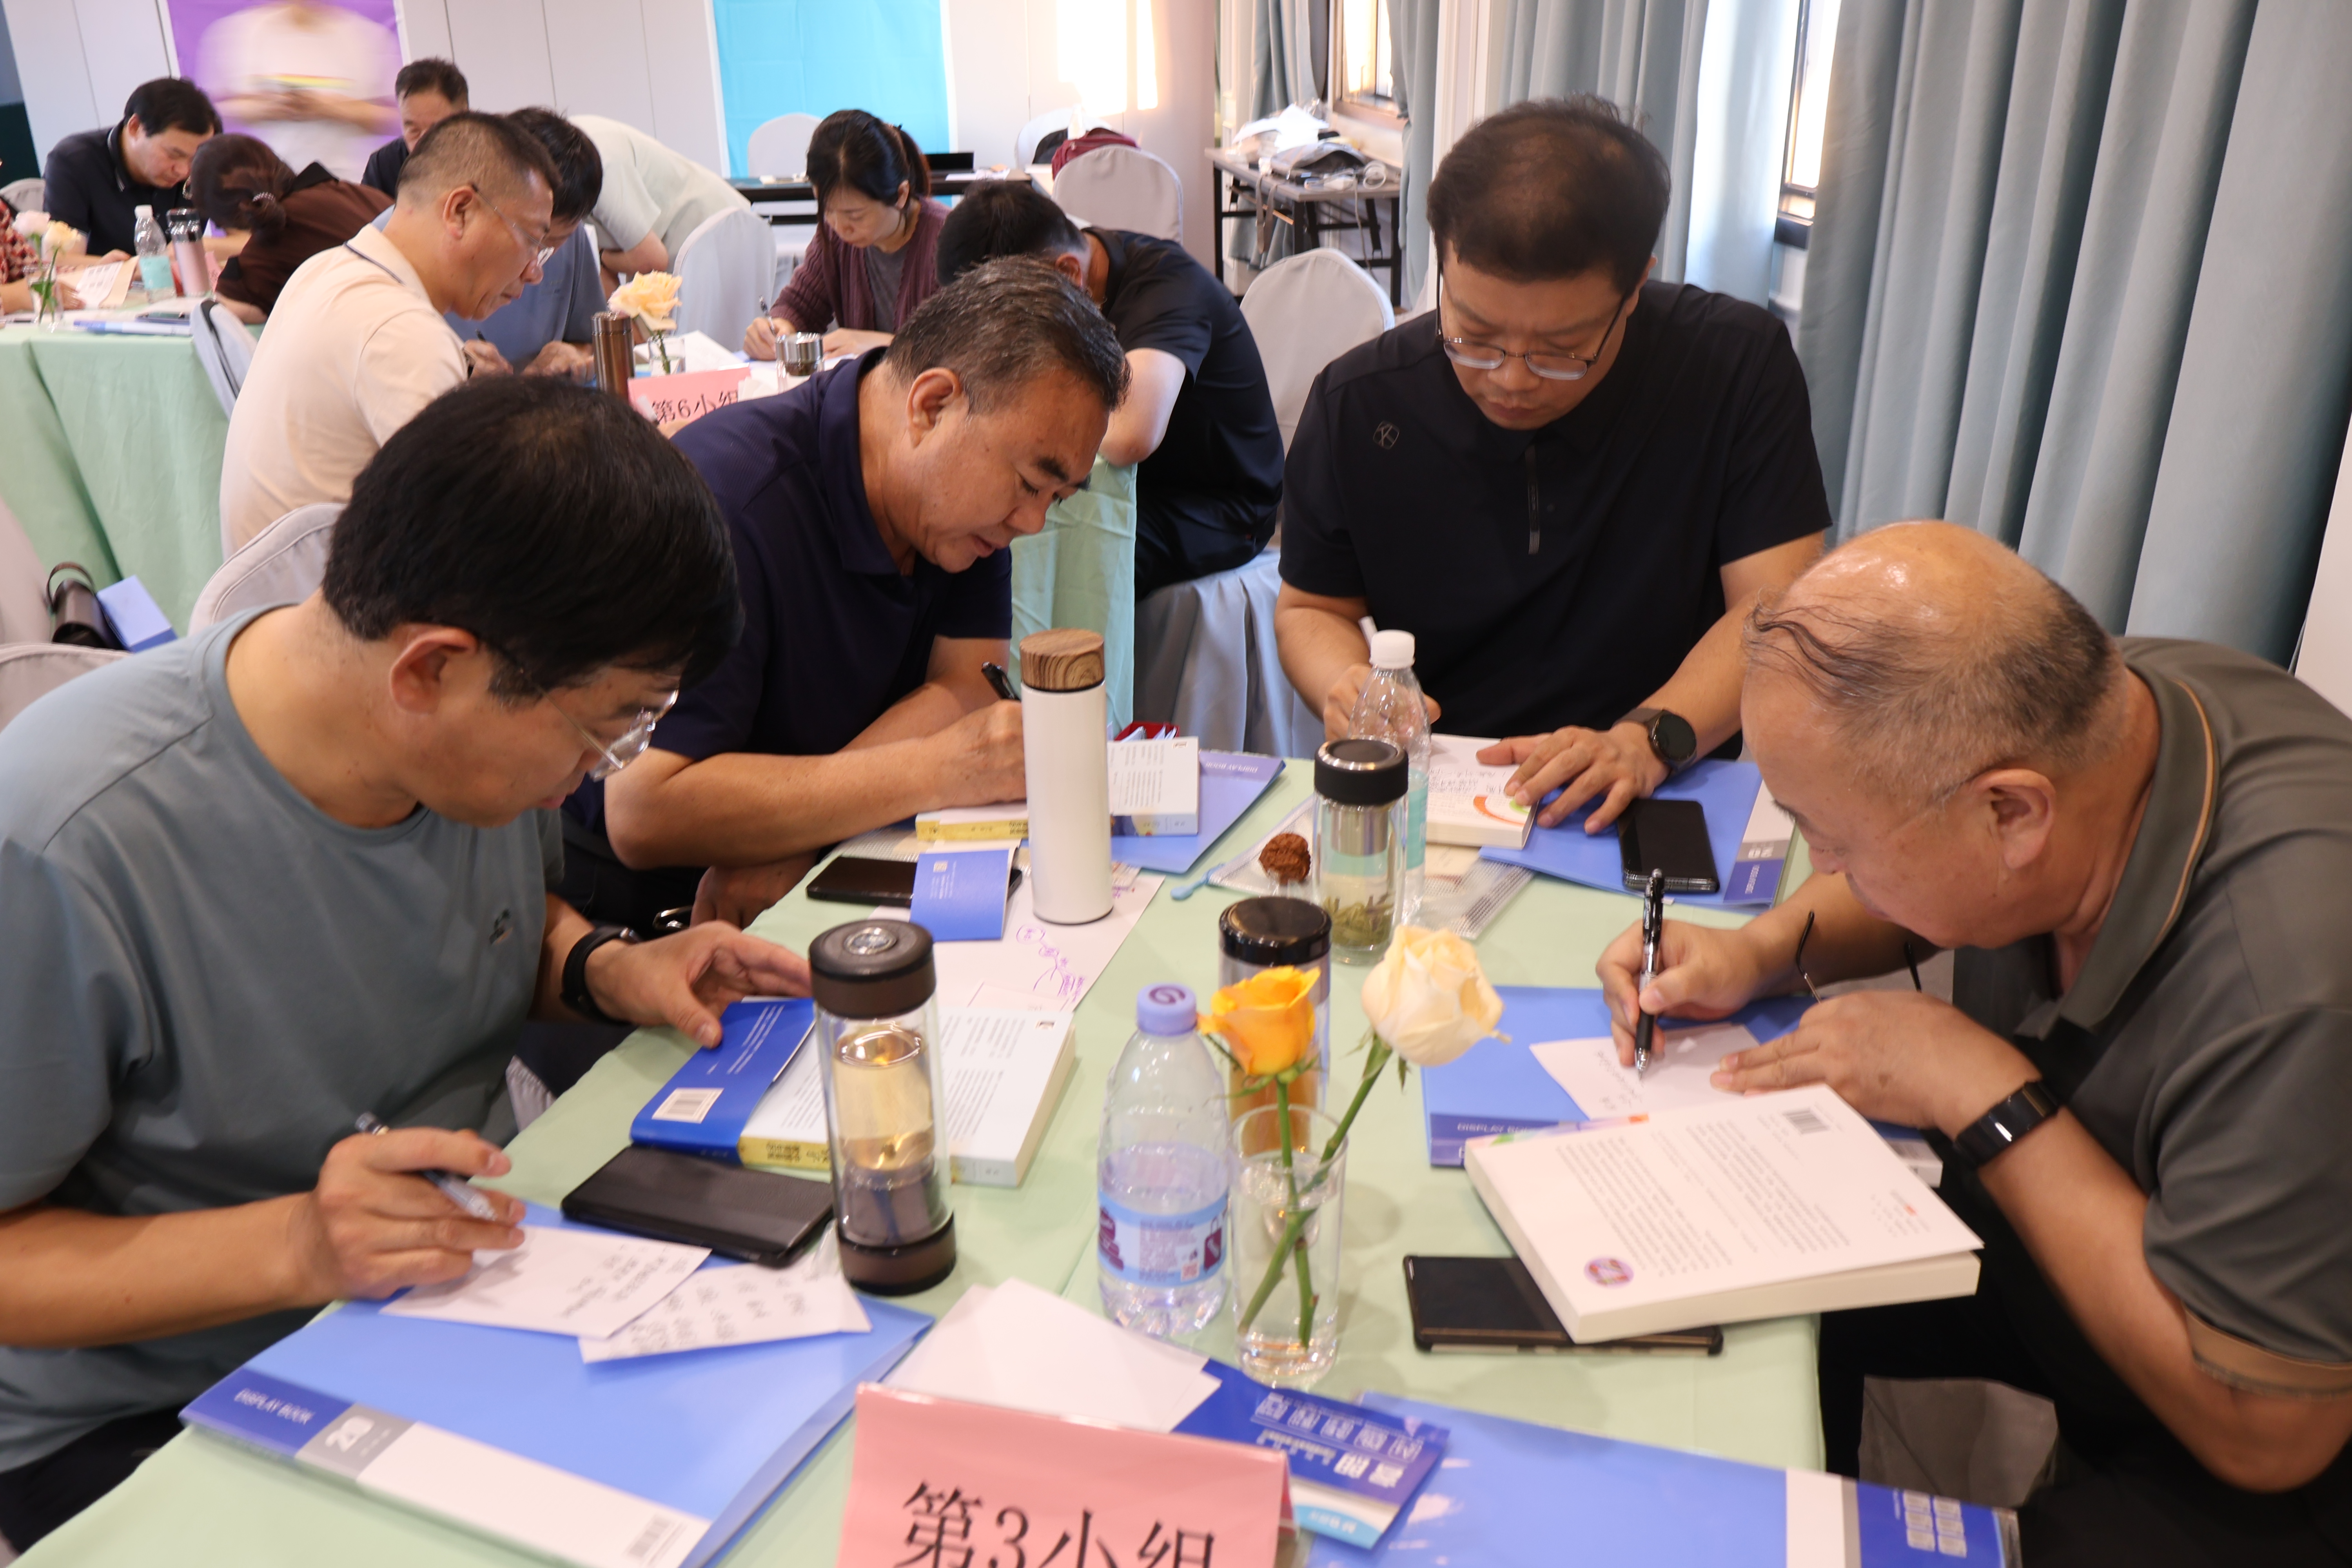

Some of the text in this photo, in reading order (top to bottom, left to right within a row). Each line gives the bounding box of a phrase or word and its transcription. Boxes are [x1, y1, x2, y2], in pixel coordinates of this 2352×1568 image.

[651, 390, 738, 425] 第6小组
[1228, 764, 1259, 773] DISPLAY
[1457, 1122, 1505, 1133] DISPLAY
[234, 1388, 282, 1413] DISPLAY
[893, 1480, 1215, 1568] 第3小组
